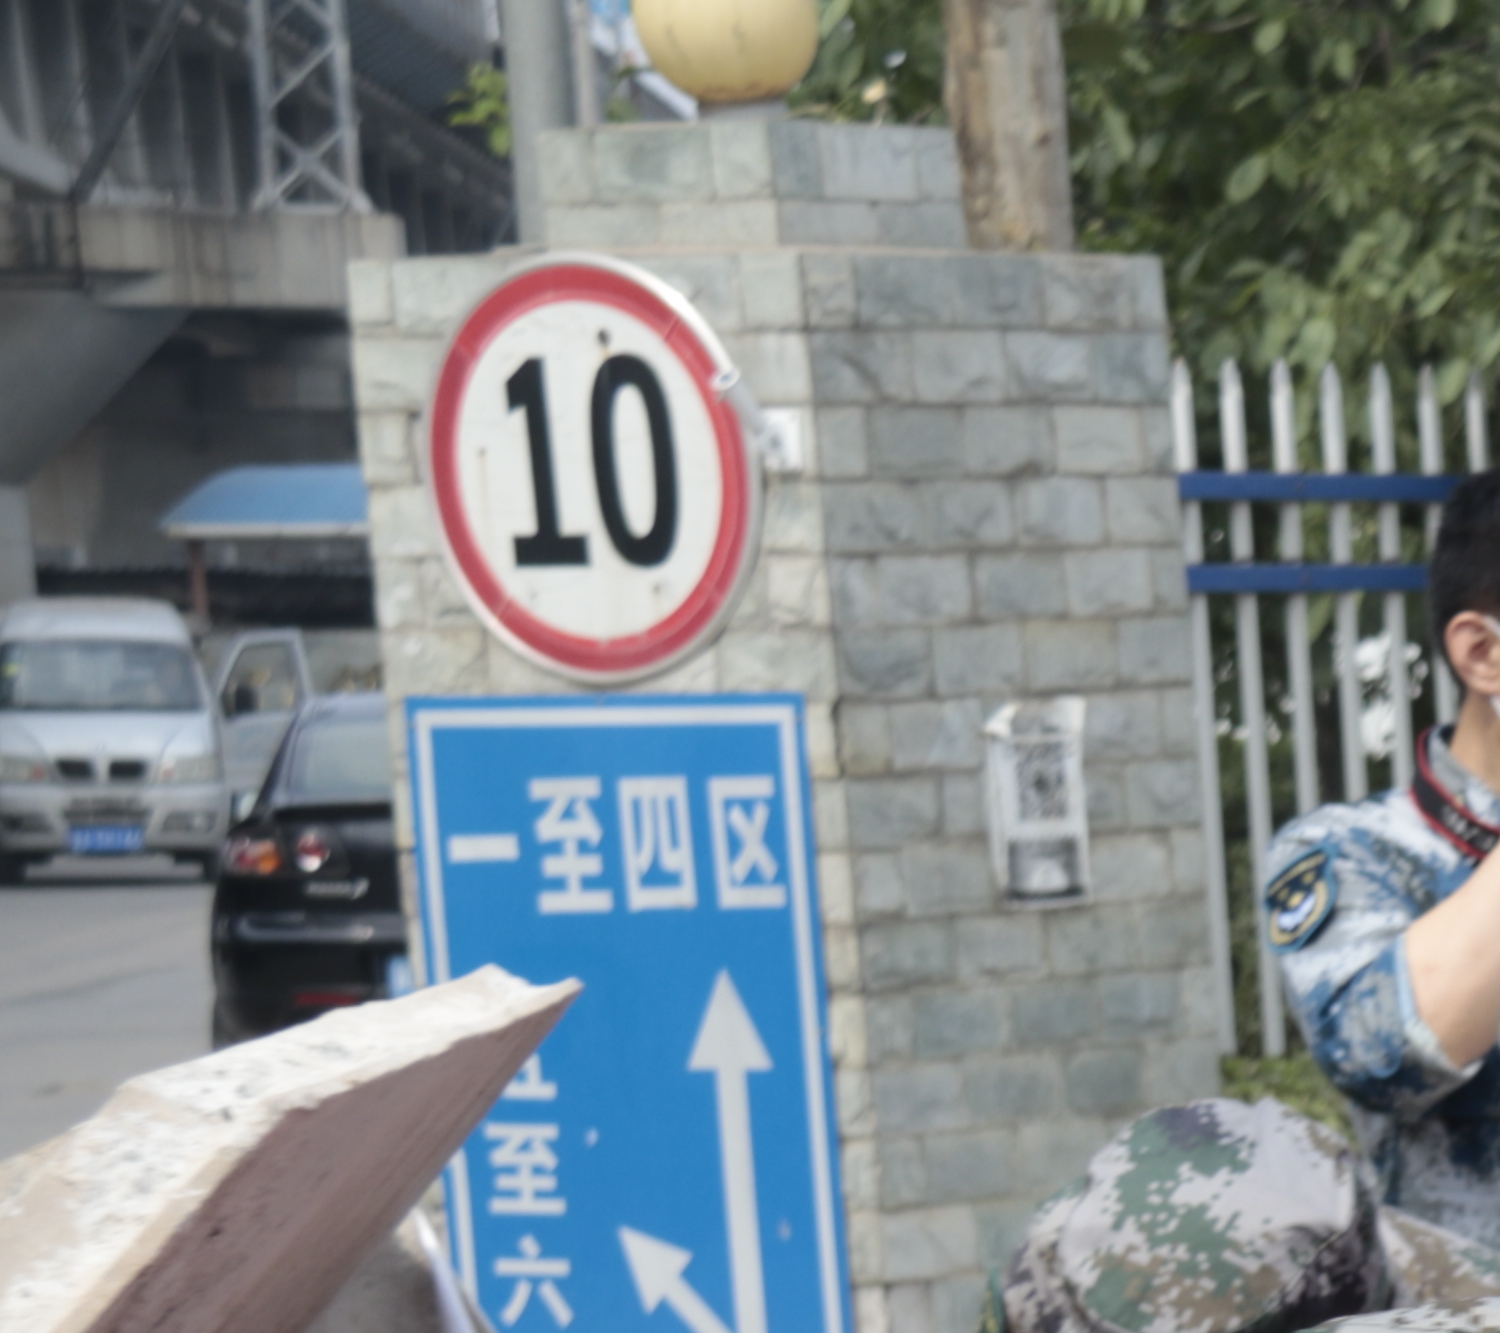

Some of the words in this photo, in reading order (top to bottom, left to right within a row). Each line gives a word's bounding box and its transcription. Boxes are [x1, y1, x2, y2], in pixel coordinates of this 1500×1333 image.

[504, 352, 681, 569] 10
[446, 775, 787, 916] 一至四区
